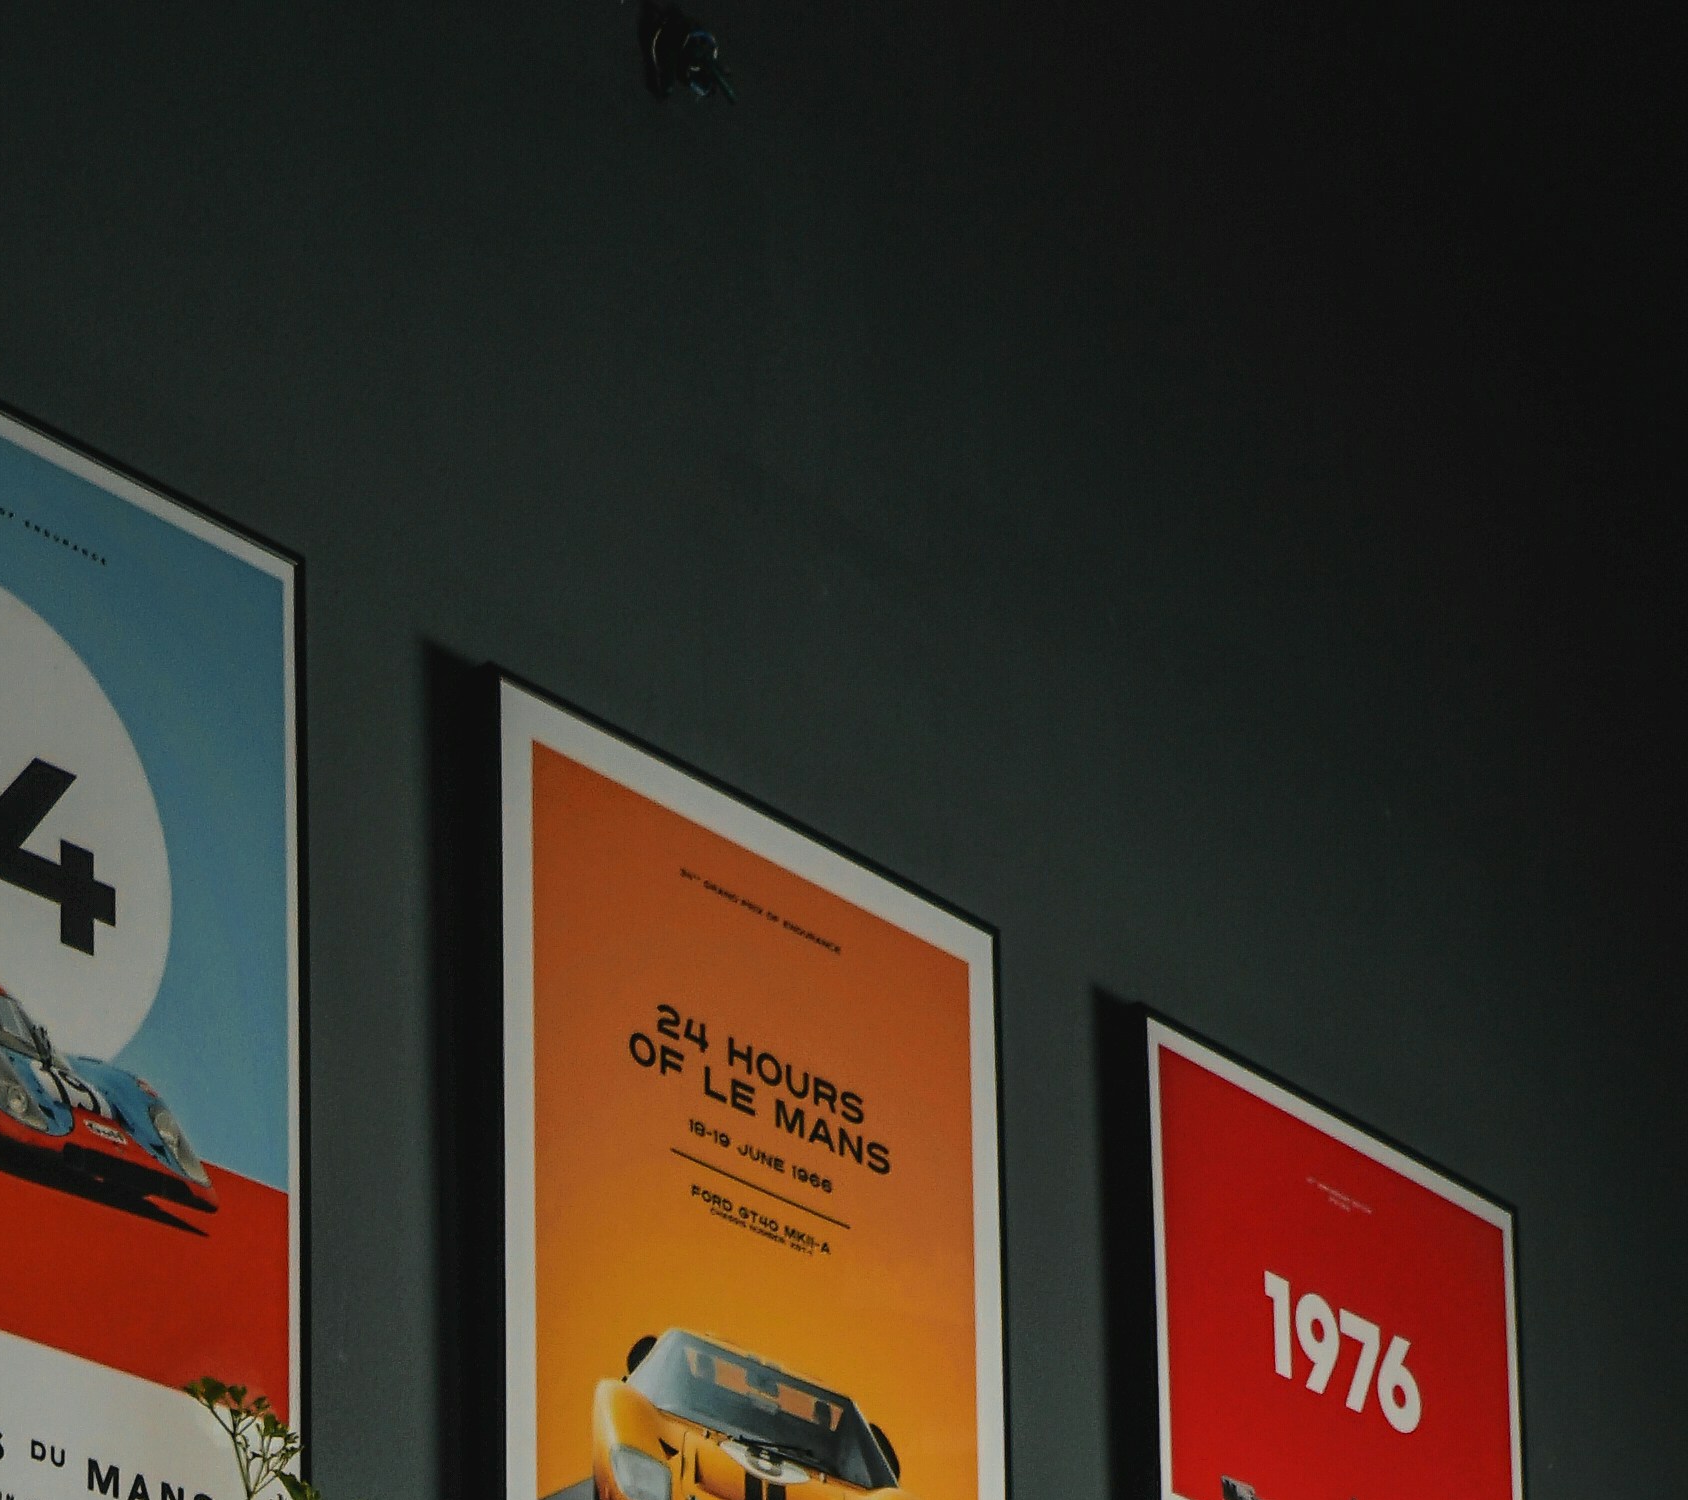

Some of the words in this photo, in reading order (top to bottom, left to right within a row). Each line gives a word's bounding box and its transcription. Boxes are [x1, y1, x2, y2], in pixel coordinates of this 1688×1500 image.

[629, 1031, 684, 1075] OF
[703, 1067, 756, 1117] LE
[775, 1099, 892, 1175] MANS
[657, 1004, 709, 1053] 24
[728, 1037, 865, 1124] HOURS
[688, 1118, 731, 1150] 18-19
[737, 1143, 785, 1173] JUNE
[792, 1165, 833, 1195] 1966
[691, 1184, 732, 1212] FORD
[739, 1206, 779, 1231] GT40
[1264, 1269, 1422, 1434] 1976
[30, 1438, 66, 1468] DU
